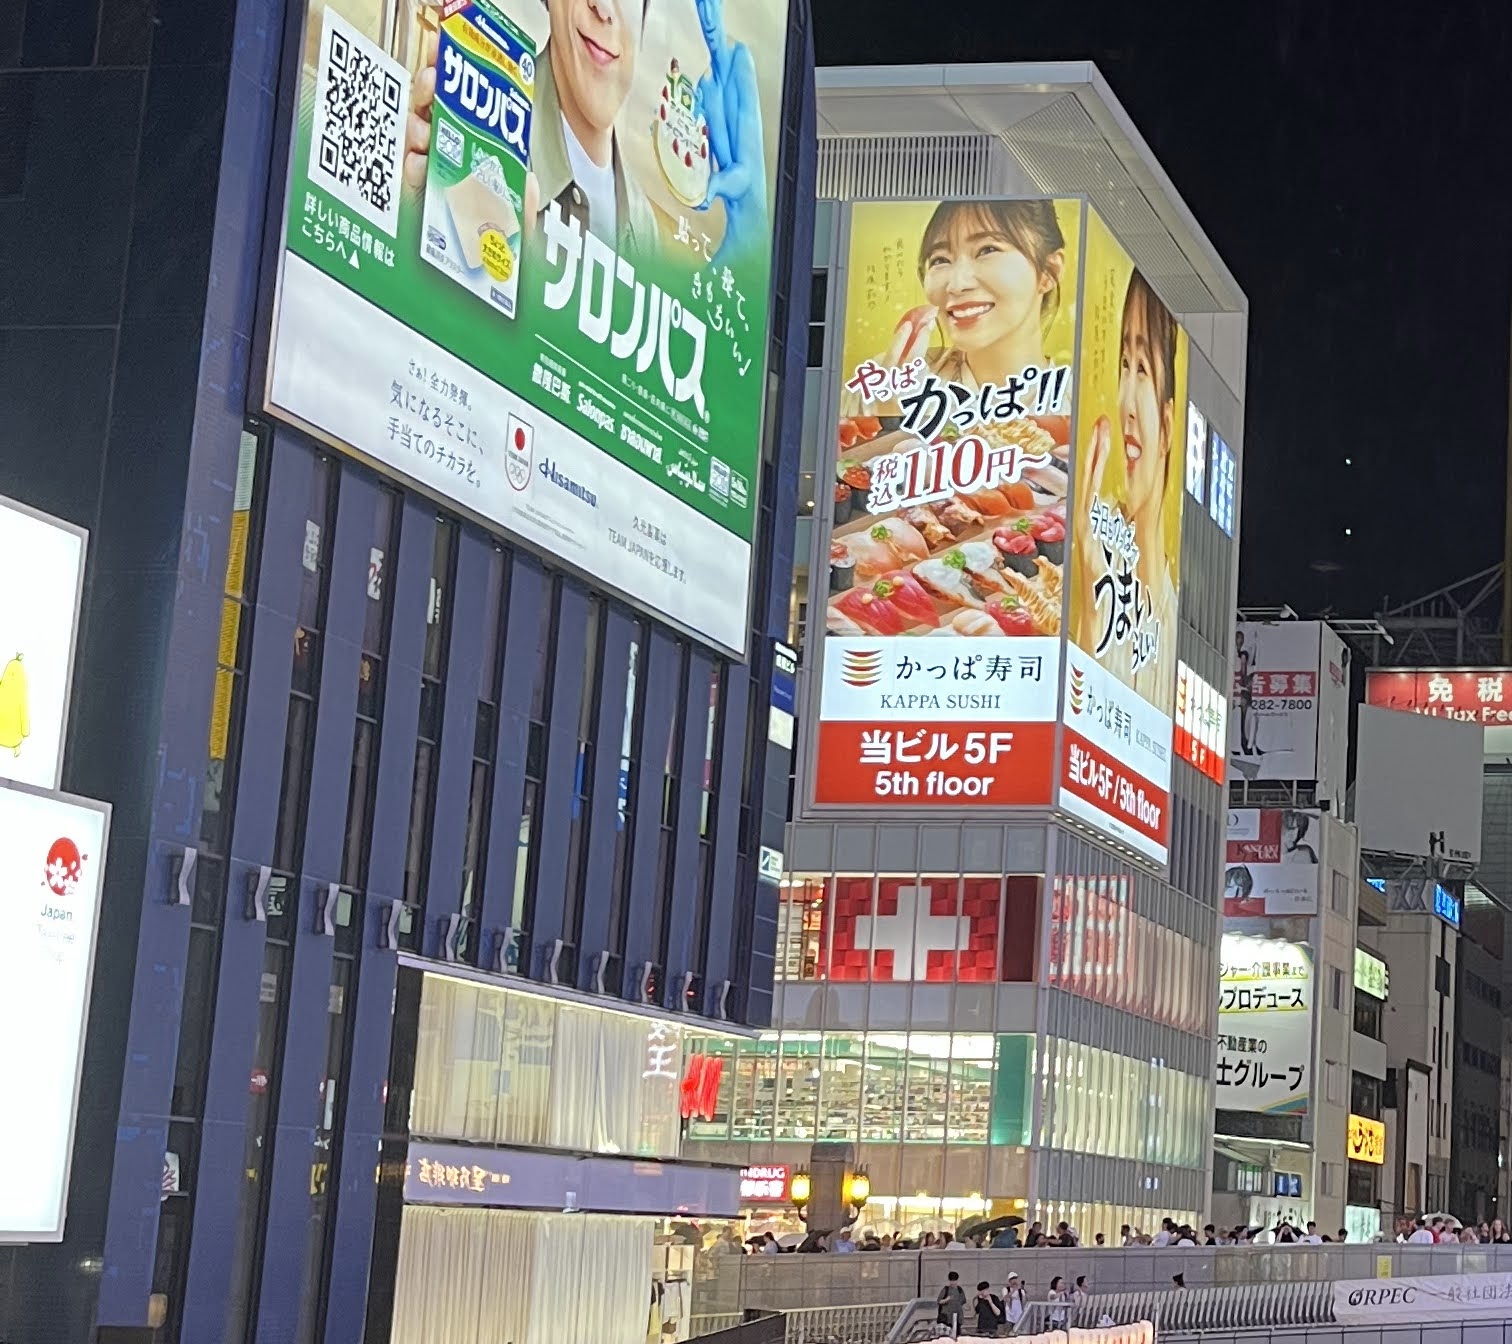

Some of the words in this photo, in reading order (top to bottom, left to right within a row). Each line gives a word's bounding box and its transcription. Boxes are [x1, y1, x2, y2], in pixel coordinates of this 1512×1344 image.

[522, 58, 532, 76] 40
[443, 45, 529, 159] サロンパス
[304, 191, 395, 269] 詳しい商品情報は
[543, 199, 708, 421] サロンパス
[847, 359, 921, 402] やっぱ
[902, 365, 1072, 441] かっぱ!!
[389, 380, 485, 456] 気になるそこに、
[387, 416, 482, 489] 手当てのチカラを。
[895, 655, 1044, 683] かっぱ寿司
[880, 694, 941, 710] KAPPA
[946, 694, 1001, 710] SUSHI
[1087, 685, 1132, 746] かっぱ寿司
[874, 771, 919, 797] 5th
[926, 771, 994, 797] floor
[1120, 779, 1136, 813] 5th
[1137, 791, 1161, 829] floor
[41, 904, 73, 921] Japan
